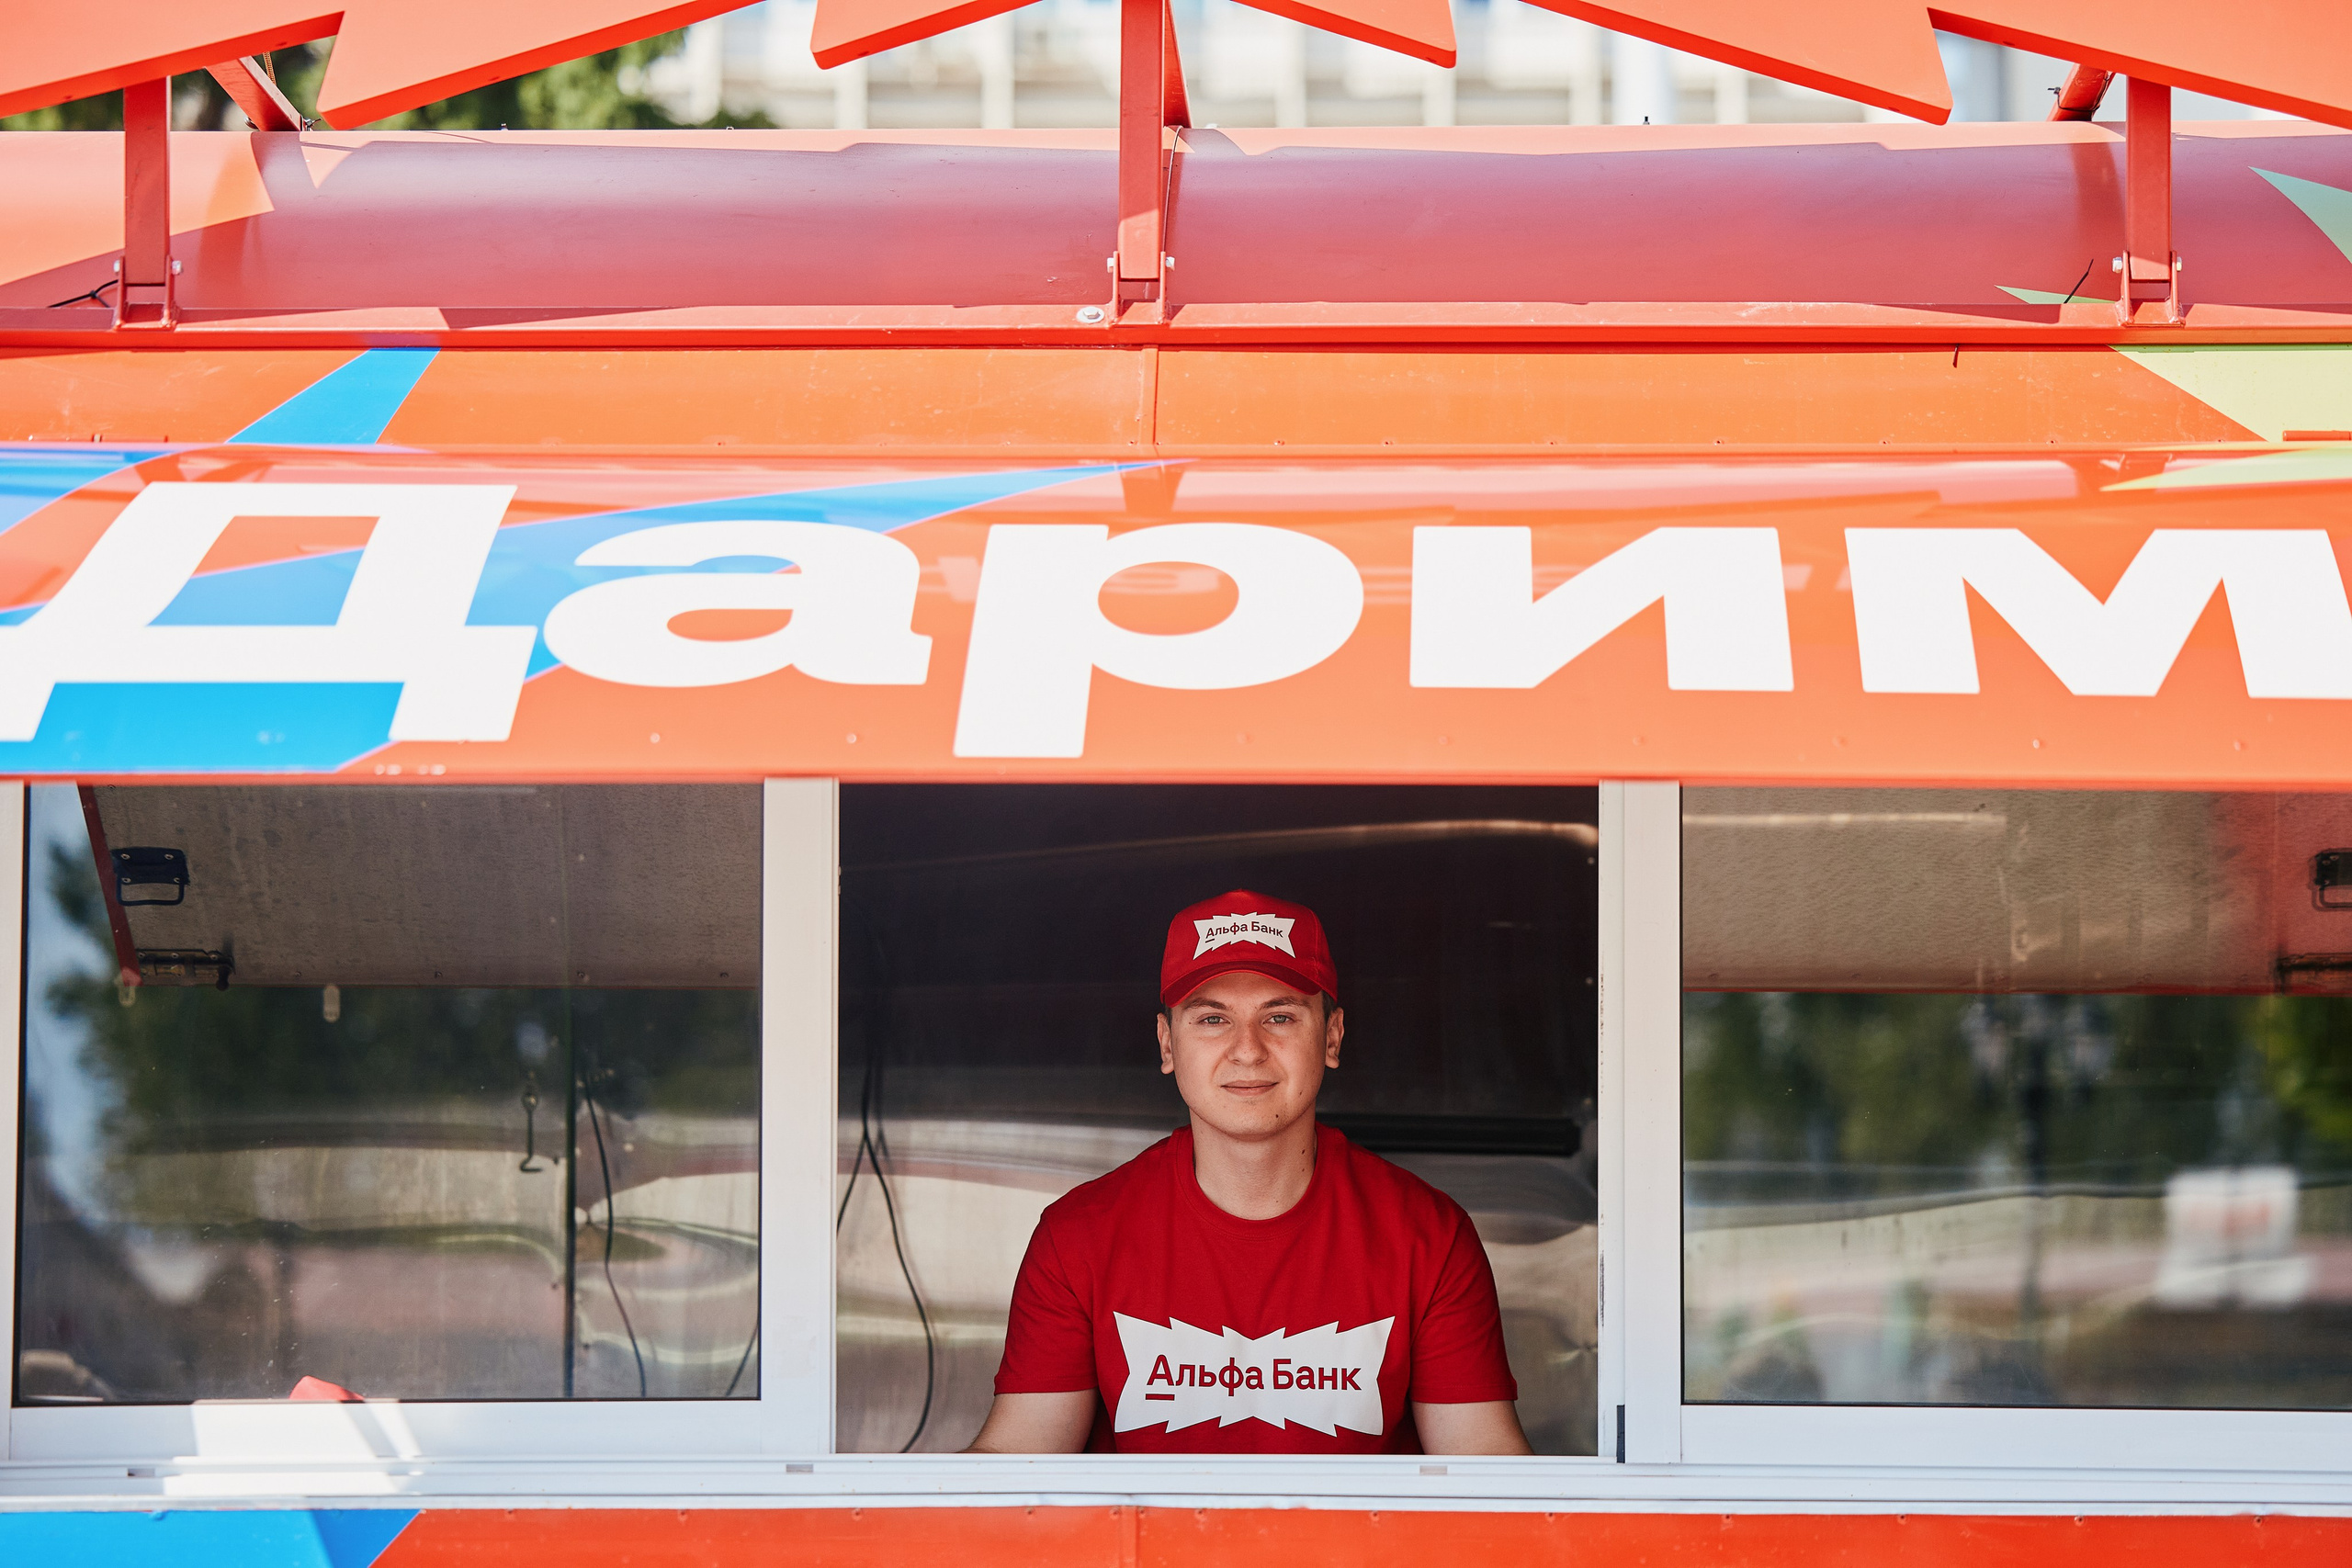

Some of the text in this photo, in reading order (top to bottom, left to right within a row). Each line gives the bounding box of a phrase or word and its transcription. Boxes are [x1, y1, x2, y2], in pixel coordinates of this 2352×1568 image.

[0, 482, 2352, 758] Дарим
[1205, 921, 1283, 942] Альфа Банк
[1145, 1354, 1363, 1401] Альфа Банк
